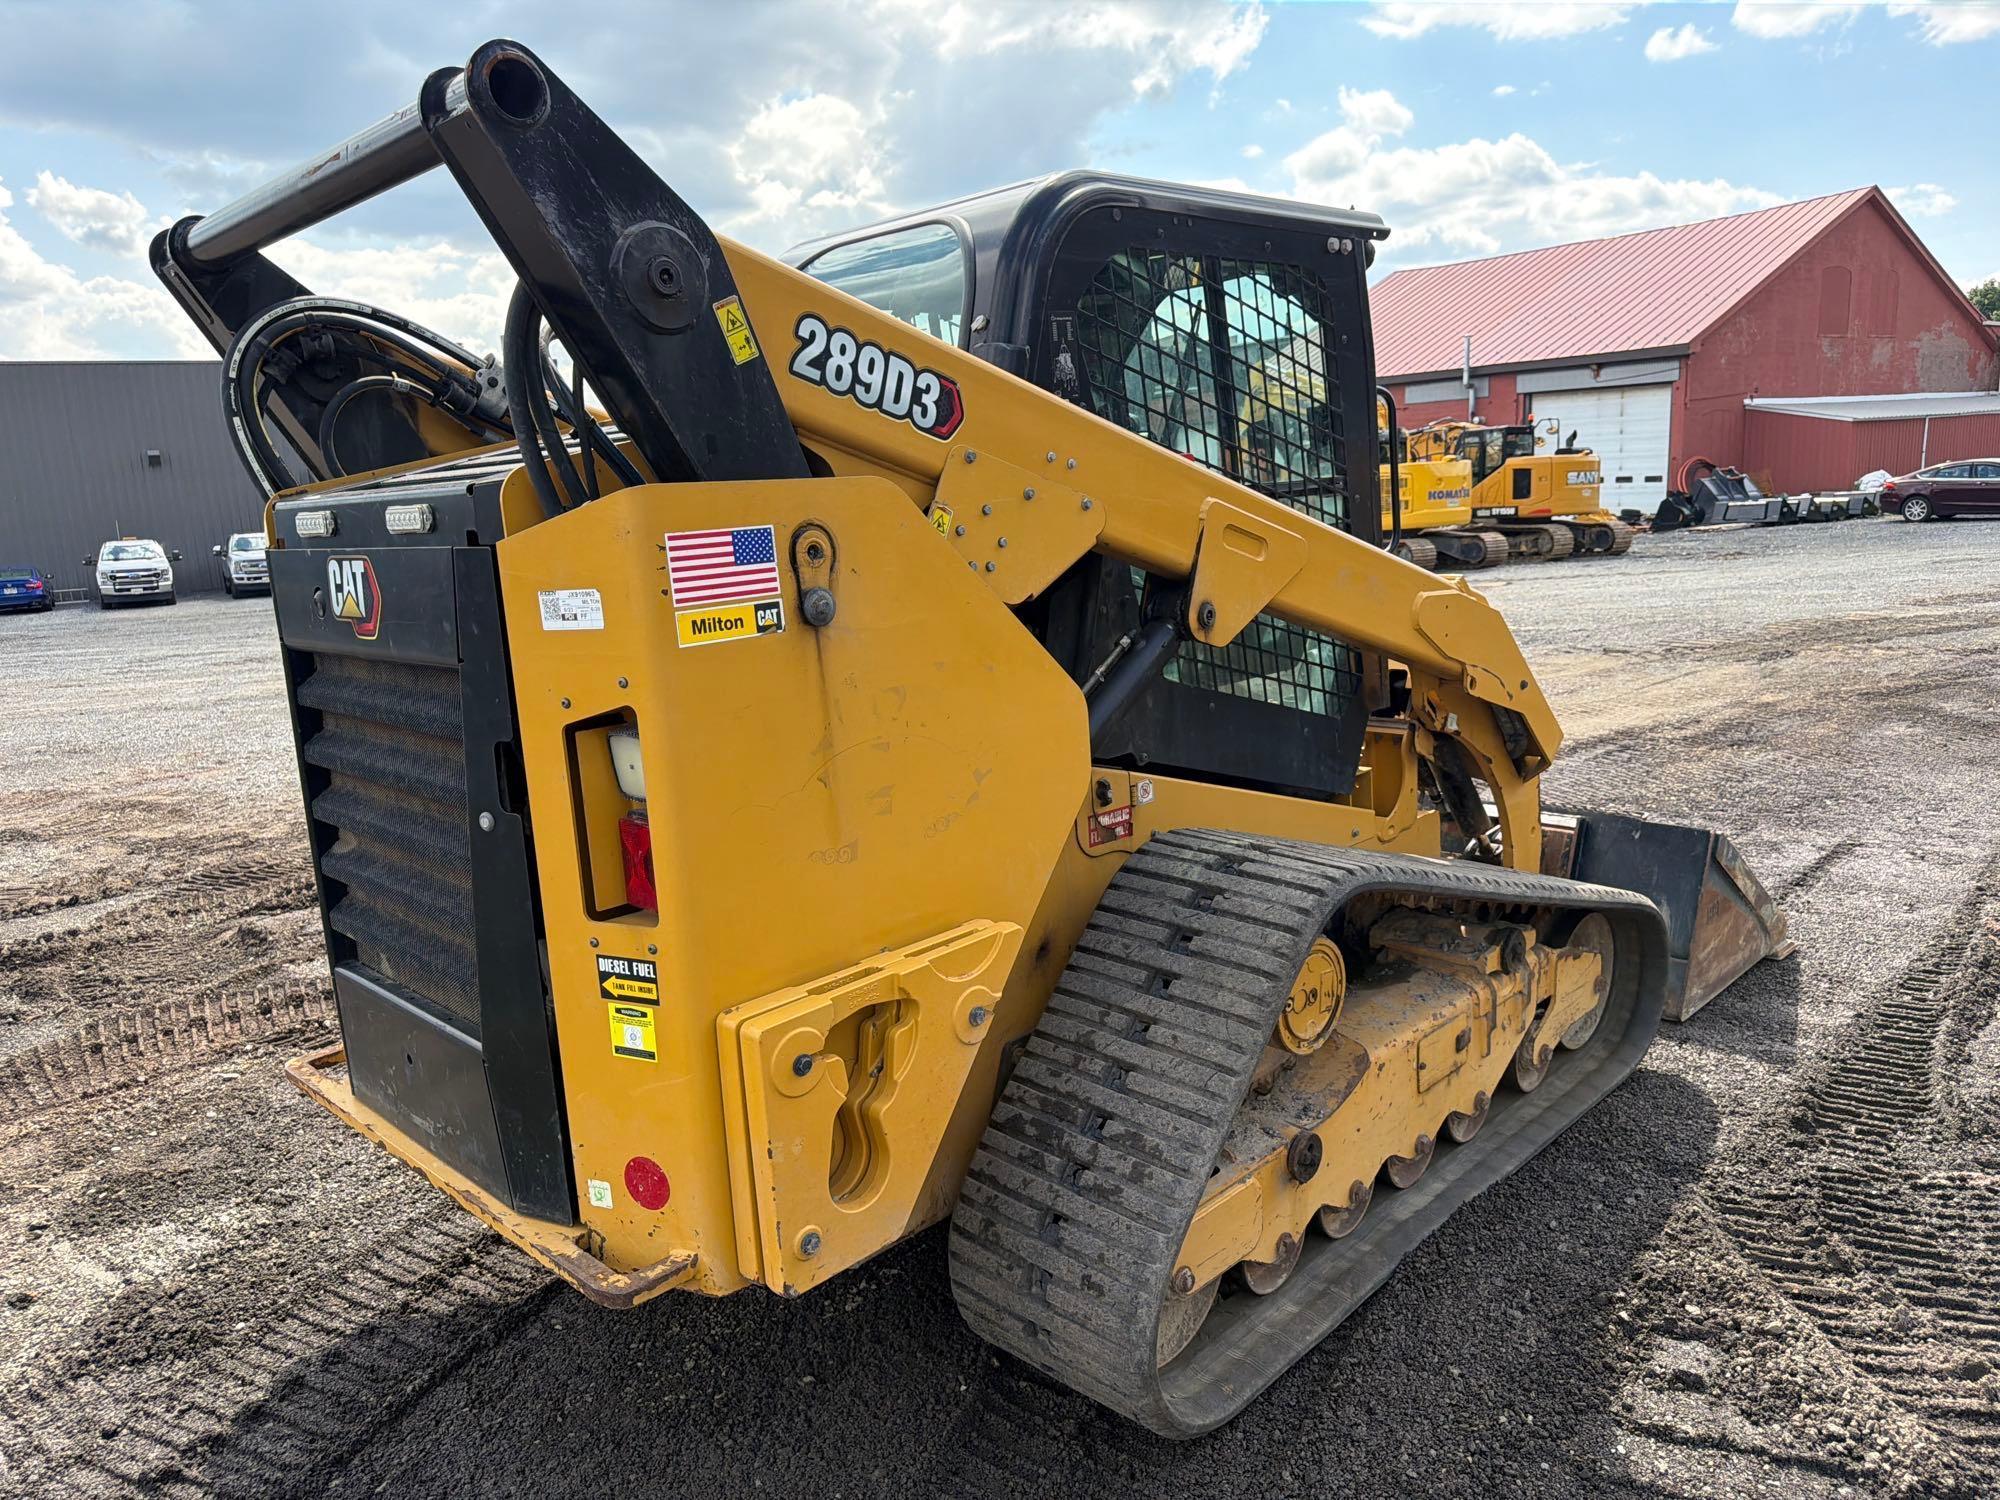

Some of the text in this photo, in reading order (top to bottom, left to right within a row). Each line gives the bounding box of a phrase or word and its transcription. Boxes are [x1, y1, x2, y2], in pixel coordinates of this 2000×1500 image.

[792, 317, 941, 429] 289D3
[328, 559, 366, 618] CAT
[691, 608, 779, 635] Milton CAT
[598, 957, 656, 978] DIESEL FUEL
[612, 982, 654, 995] TANK FILL INSIDE
[621, 1009, 642, 1017] WARNING
